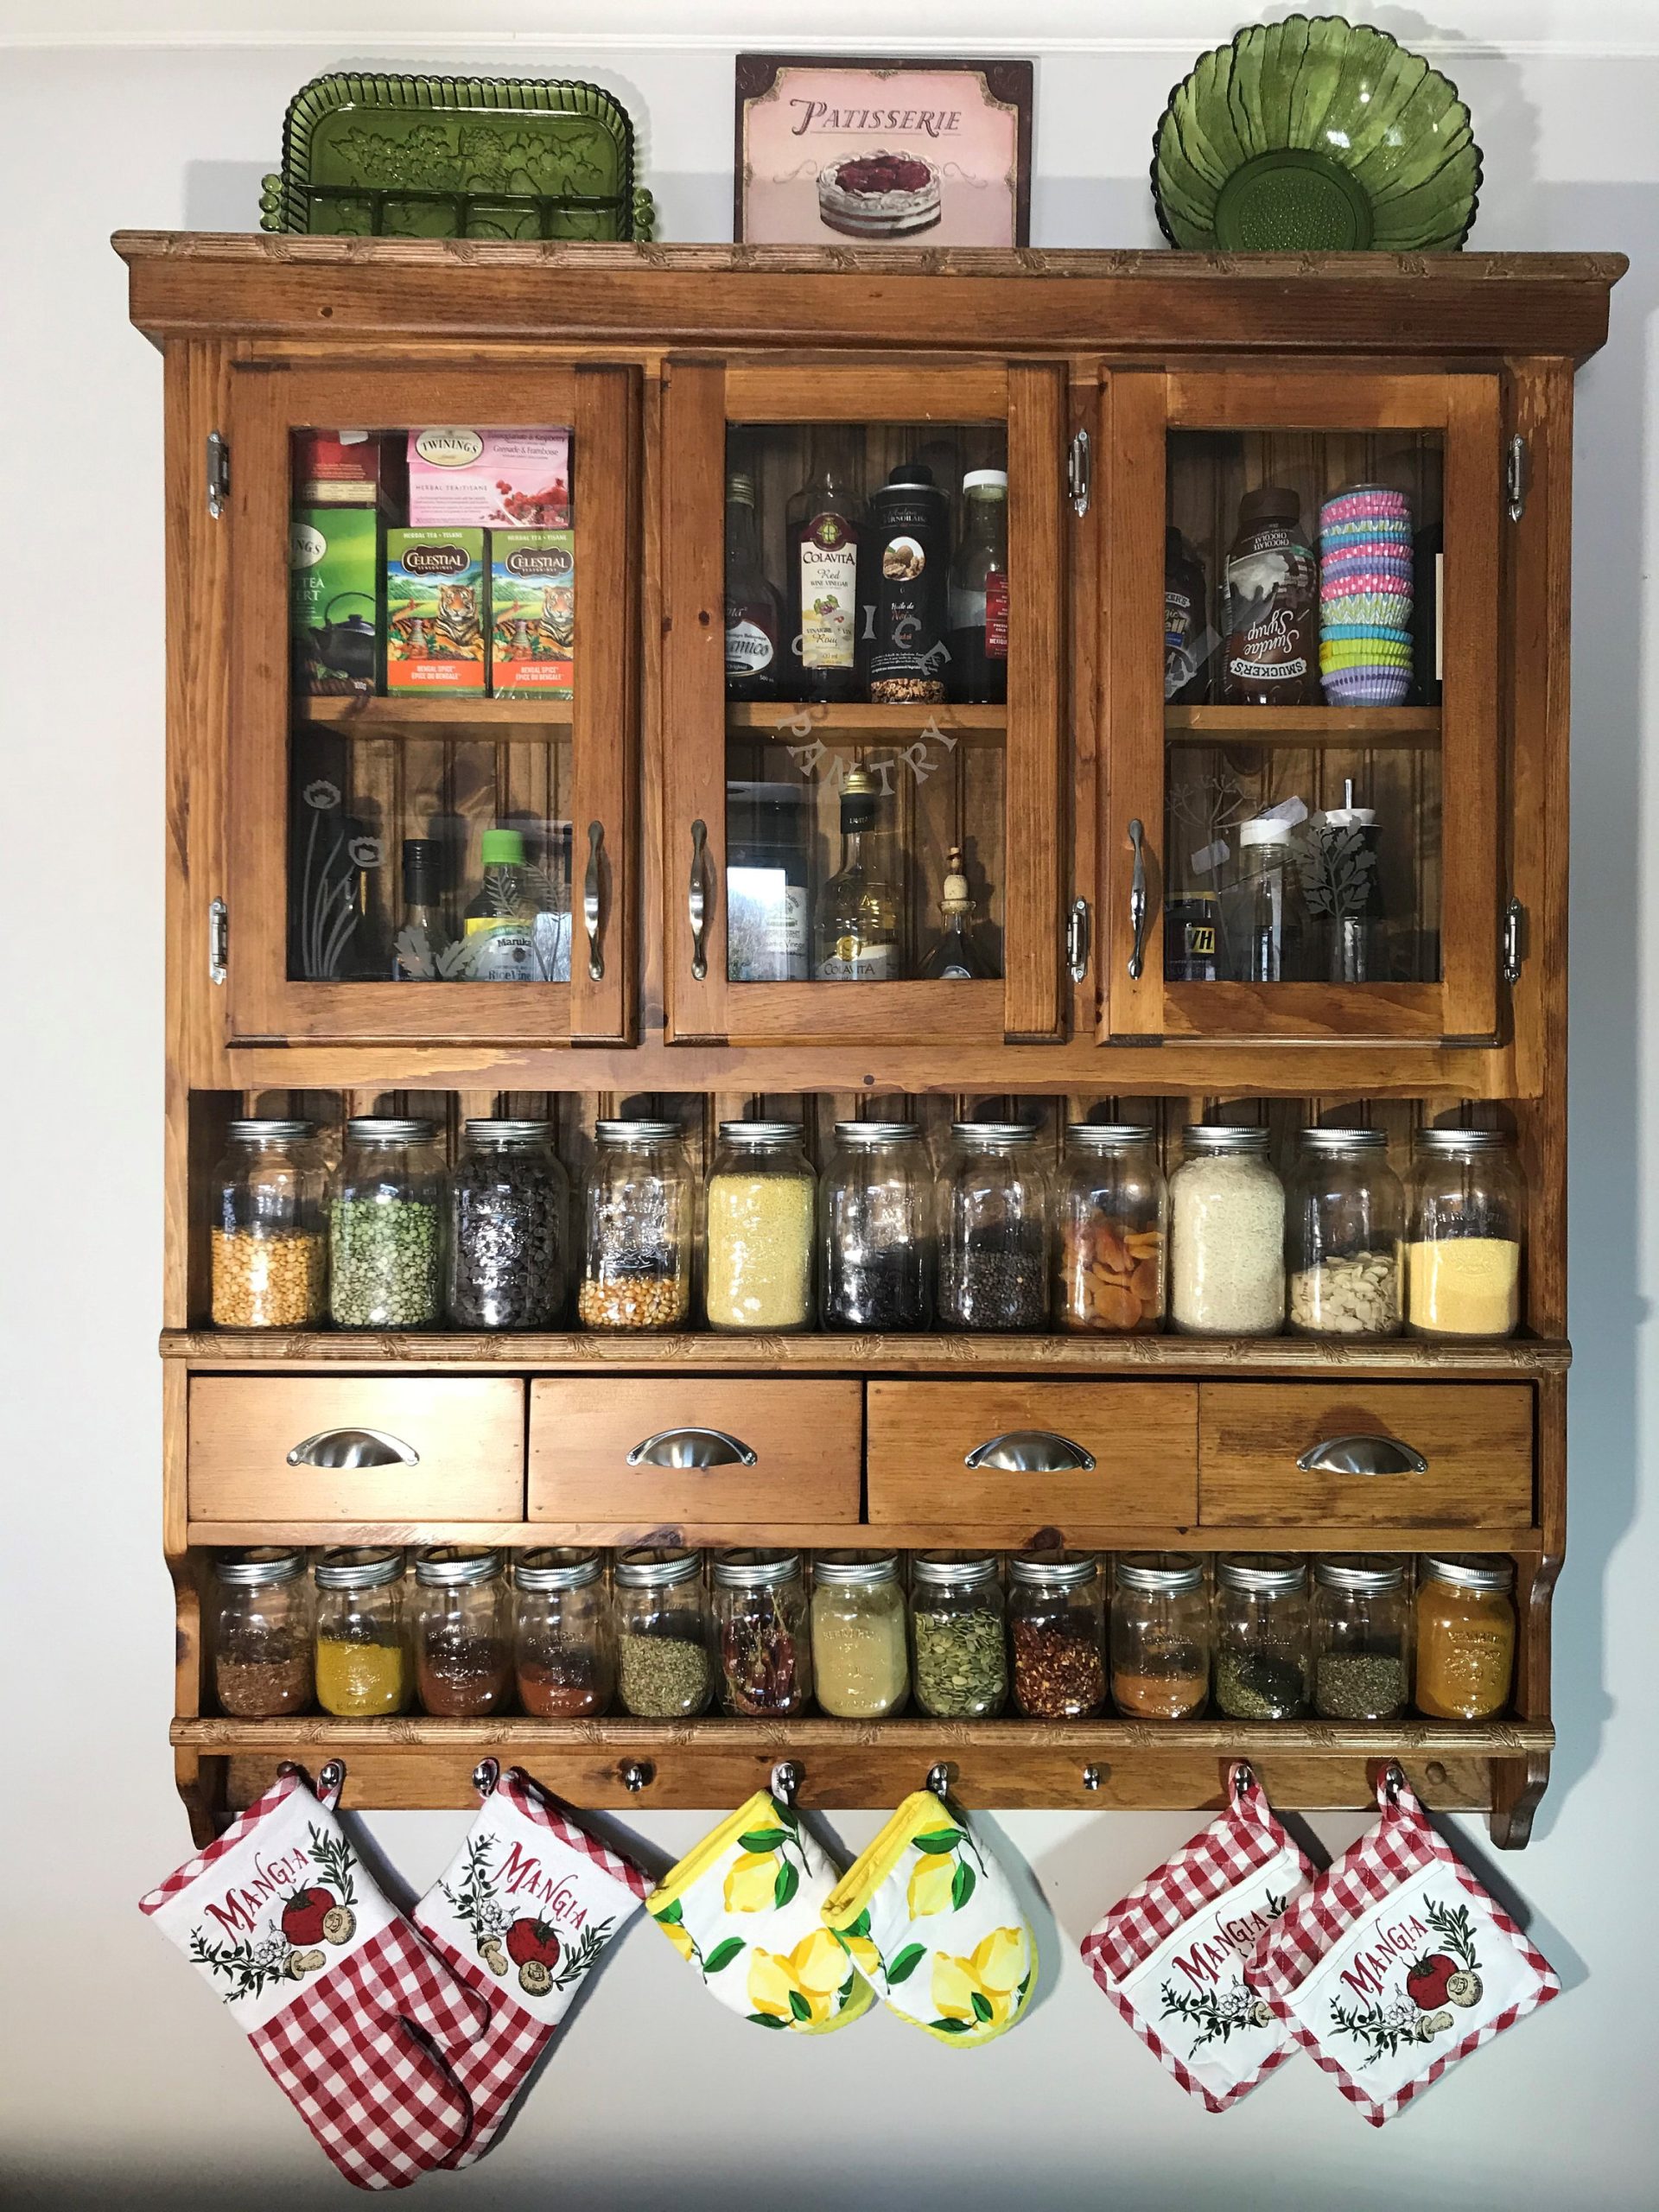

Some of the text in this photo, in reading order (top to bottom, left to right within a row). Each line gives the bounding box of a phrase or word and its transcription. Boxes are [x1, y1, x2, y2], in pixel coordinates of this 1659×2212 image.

[790, 99, 962, 137] PATISSERIE
[421, 439, 479, 454] TWININGS
[296, 538, 321, 555] NGS
[407, 552, 465, 568] CELESTIAL
[511, 554, 569, 569] CELESTIAL
[803, 551, 855, 566] COLAVITA
[302, 577, 325, 588] TEA
[817, 569, 840, 580] Red
[296, 590, 321, 601] ERT
[1166, 608, 1179, 620] gic
[1247, 607, 1294, 641] Syrup
[1243, 629, 1300, 659] Sundae
[1234, 661, 1305, 678] SMUCKER'S
[775, 710, 958, 798] PANTRY
[497, 938, 532, 948] Maruka
[824, 963, 876, 976] COLAVITA
[489, 1840, 588, 1930] MANGIA
[204, 1847, 310, 1948] MANGIA
[1172, 1910, 1270, 1994] MANGIA
[1340, 1914, 1429, 2011] MANGIA
